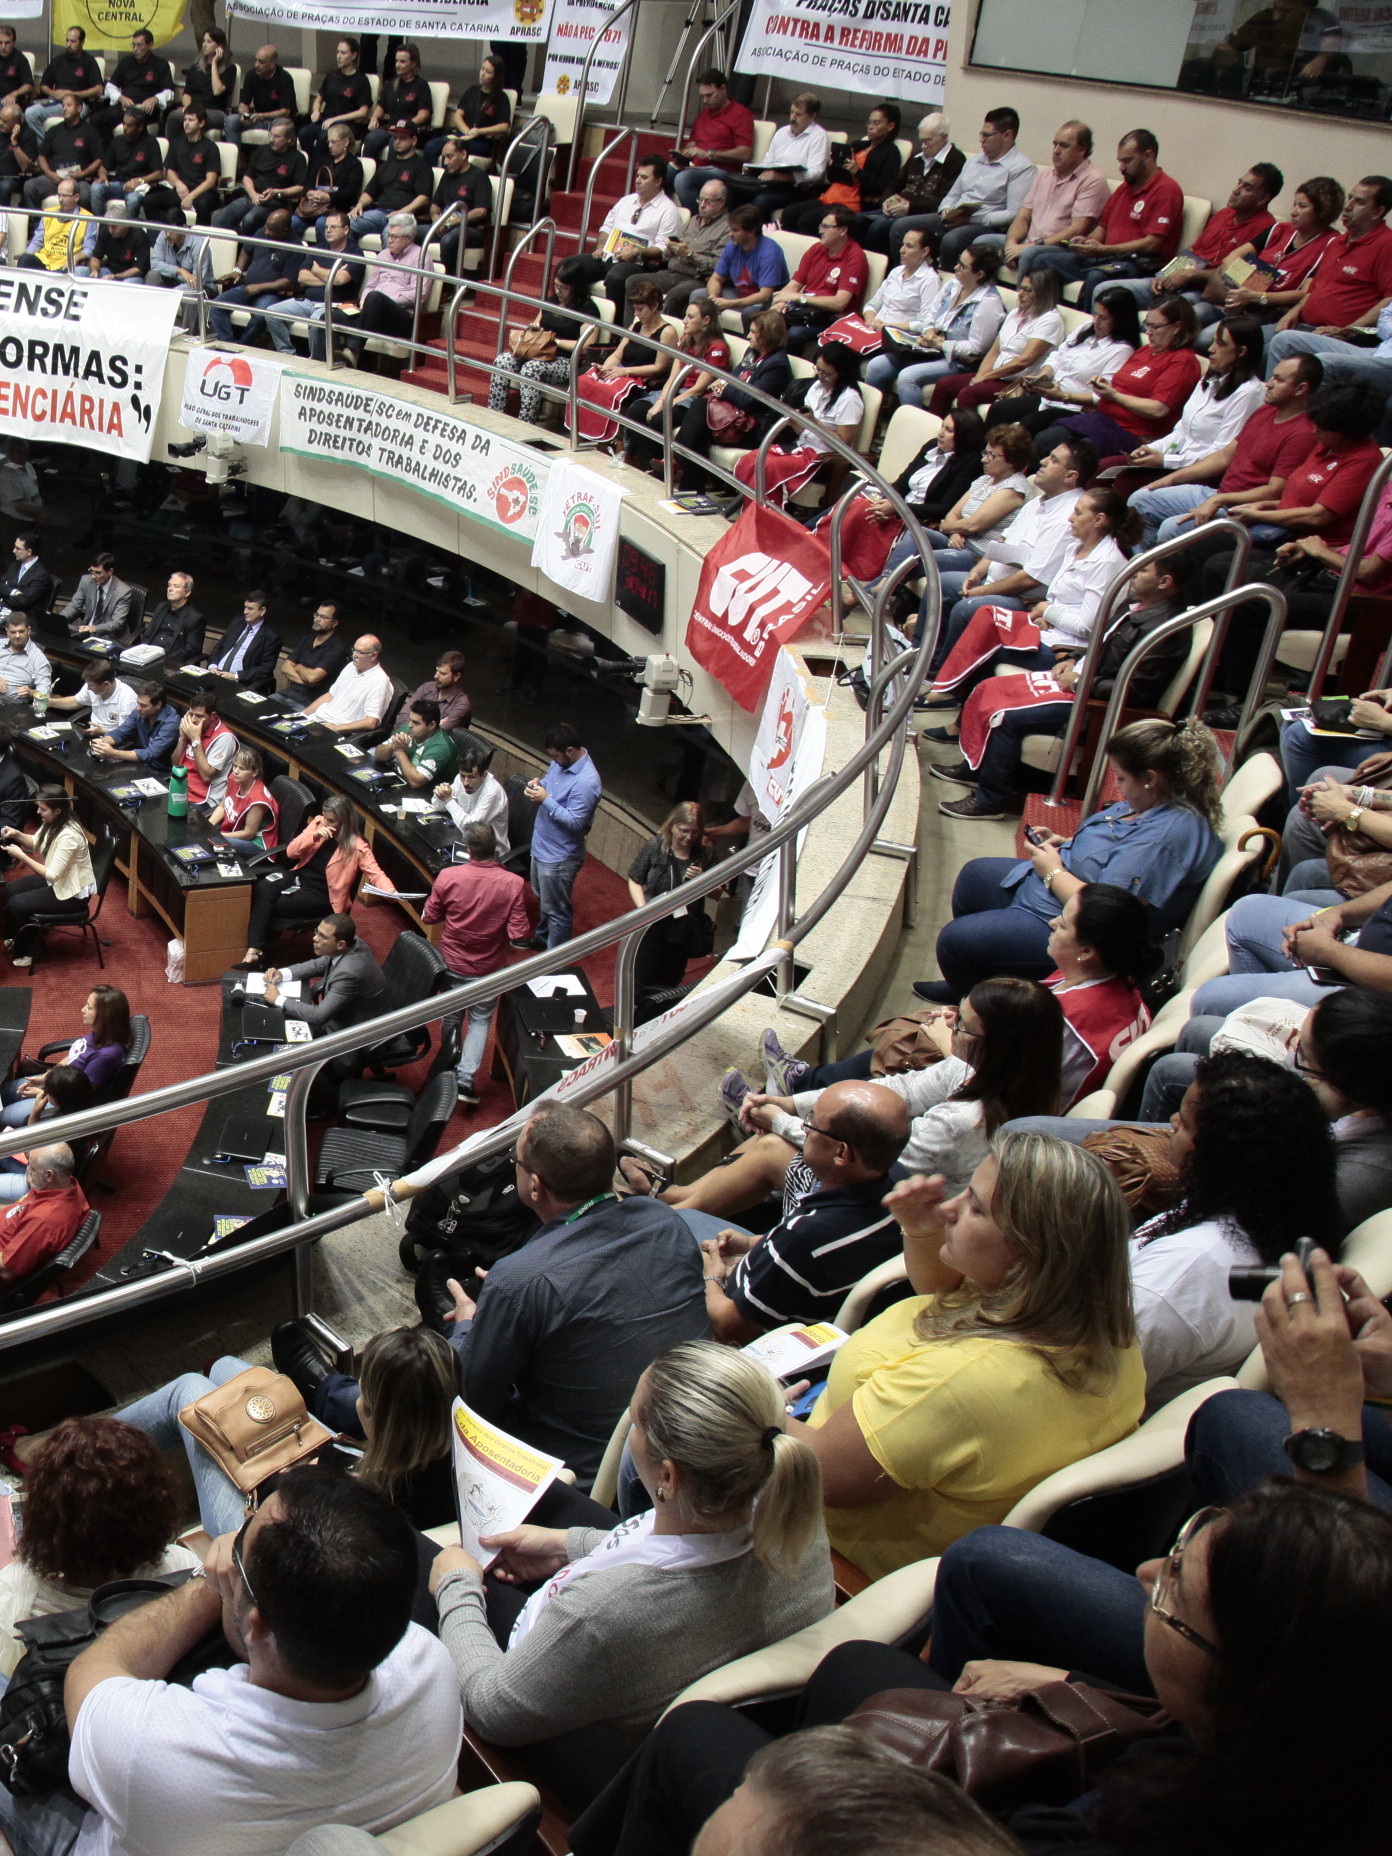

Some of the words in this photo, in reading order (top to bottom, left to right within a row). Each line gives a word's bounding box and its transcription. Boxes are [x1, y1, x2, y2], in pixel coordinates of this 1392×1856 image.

[98, 11, 145, 22] CENTRAL
[109, 0, 135, 10] NOVA
[795, 0, 861, 18] PRAÇAS
[880, 0, 931, 25] SANTA
[226, 3, 284, 18] ASSOCIAÇÃO
[287, 10, 299, 20] DE
[301, 12, 340, 25] PRAÇAS
[342, 16, 356, 25] DO
[358, 17, 396, 28] ESTADO
[399, 19, 412, 29] DE
[415, 20, 447, 31] SANTA
[450, 23, 500, 34] CATARINA
[510, 26, 542, 37] APRASC
[556, 21, 573, 39] NÃO
[580, 25, 595, 40] PEC
[765, 14, 820, 41] CONTRA
[823, 23, 835, 44] A
[838, 26, 904, 55] REFORMA
[905, 35, 931, 58] DA
[811, 55, 827, 67] DE
[829, 58, 871, 75] PRAÇAS
[873, 65, 890, 77] DO
[200, 378, 251, 405] UGT
[196, 406, 211, 417] GERAL
[202, 418, 218, 428] SANTA
[294, 383, 394, 419] SINDSAÚDE/SC
[395, 408, 412, 423] em
[413, 412, 467, 446] DEFESA
[471, 434, 491, 457] DA
[298, 407, 414, 452] APOSENTADORIA
[419, 439, 429, 456] E
[433, 443, 462, 469] DOS
[307, 428, 372, 458] DIREITOS
[378, 447, 478, 503] TRABALHISTAS.
[574, 560, 593, 573] CUT
[709, 552, 813, 642] CUT
[460, 1422, 469, 1435] da
[470, 1435, 541, 1482] Aposentadoria
[466, 1417, 483, 1434] Defesa
[483, 1432, 493, 1441] dos
[494, 1440, 515, 1454] Direitos
[516, 1451, 548, 1471] Trabalhistas
